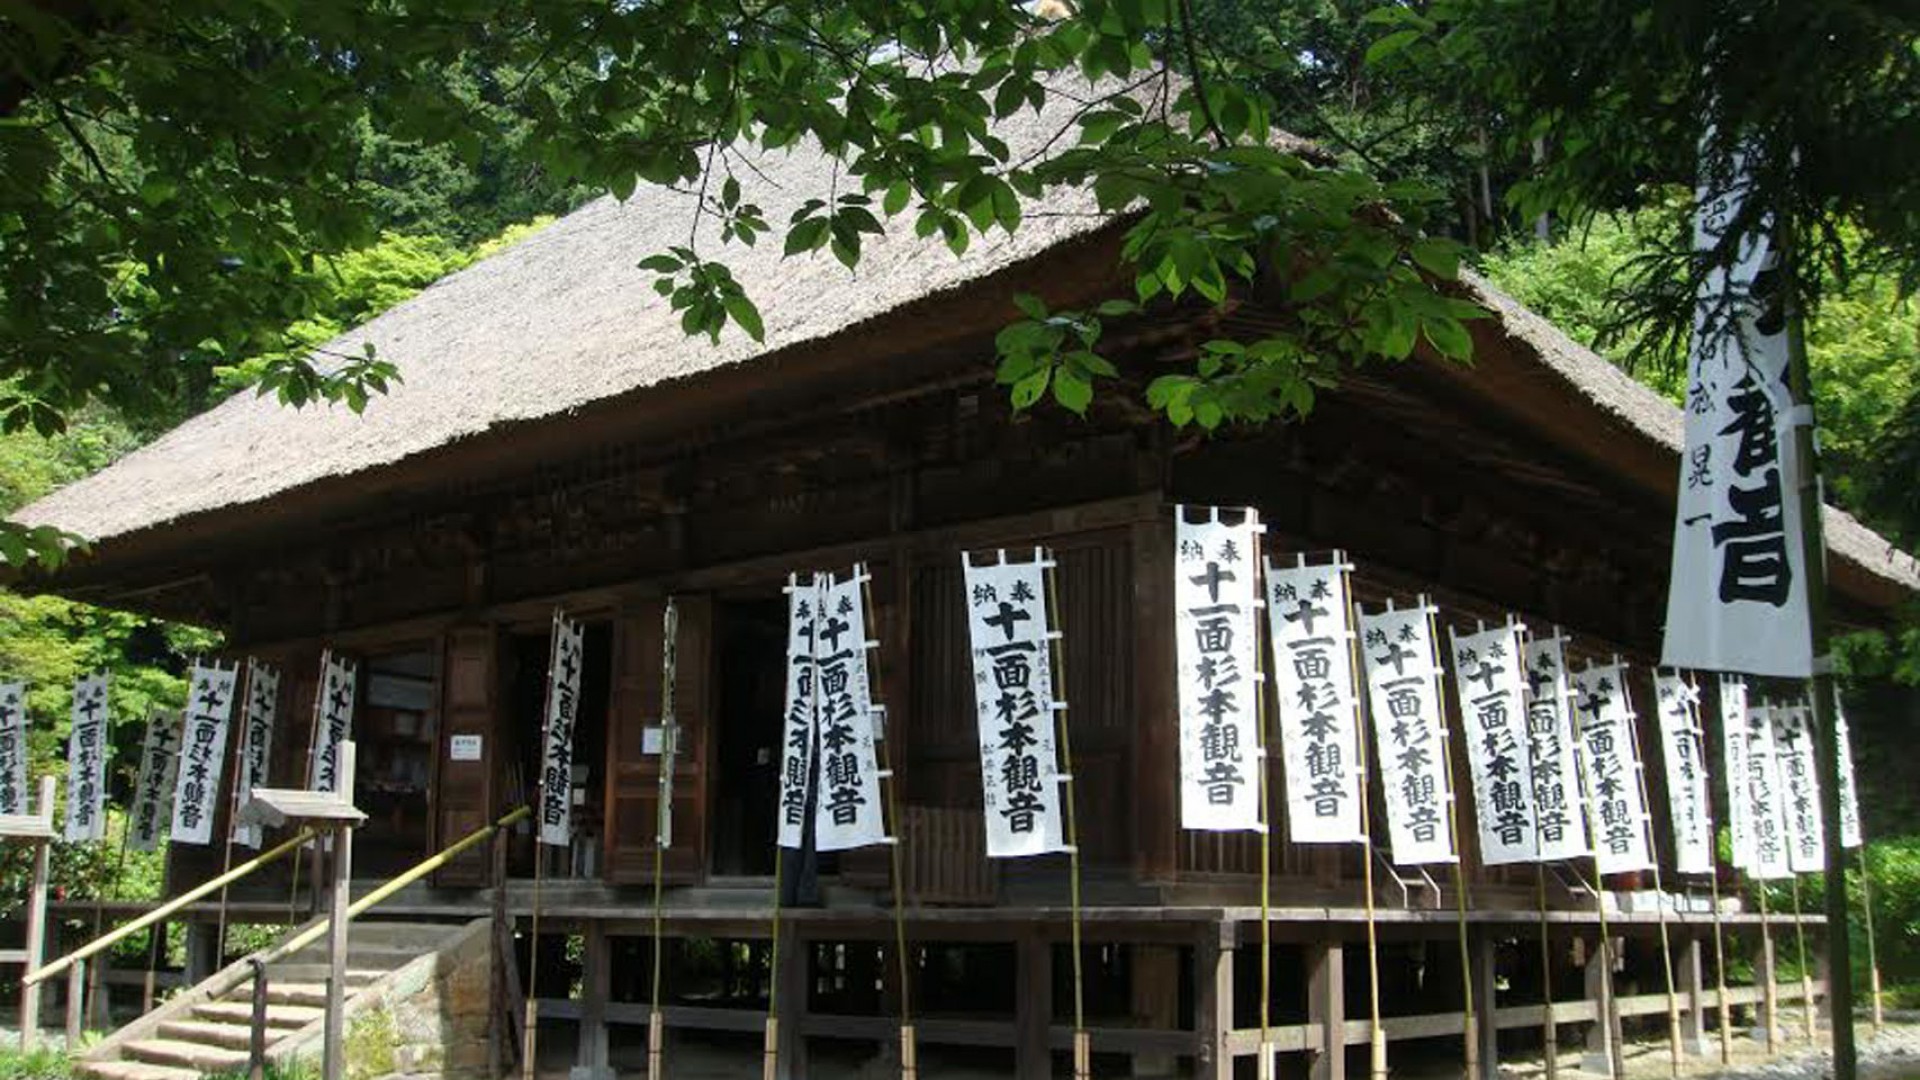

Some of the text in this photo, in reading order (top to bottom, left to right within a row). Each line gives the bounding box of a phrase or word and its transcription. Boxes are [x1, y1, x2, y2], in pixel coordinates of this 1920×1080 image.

[816, 617, 866, 826] 十一面杉本観音
[982, 602, 1046, 834] 十一面杉本観音
[1188, 562, 1245, 806] 十一面杉本観音
[1284, 600, 1349, 818] 十一面杉本観音
[1375, 644, 1443, 843] 十一面杉本観音
[1467, 661, 1530, 847] 十一面杉本観音
[1527, 671, 1572, 843] 十一面杉本観音
[1578, 693, 1636, 855] 十一面杉本観音
